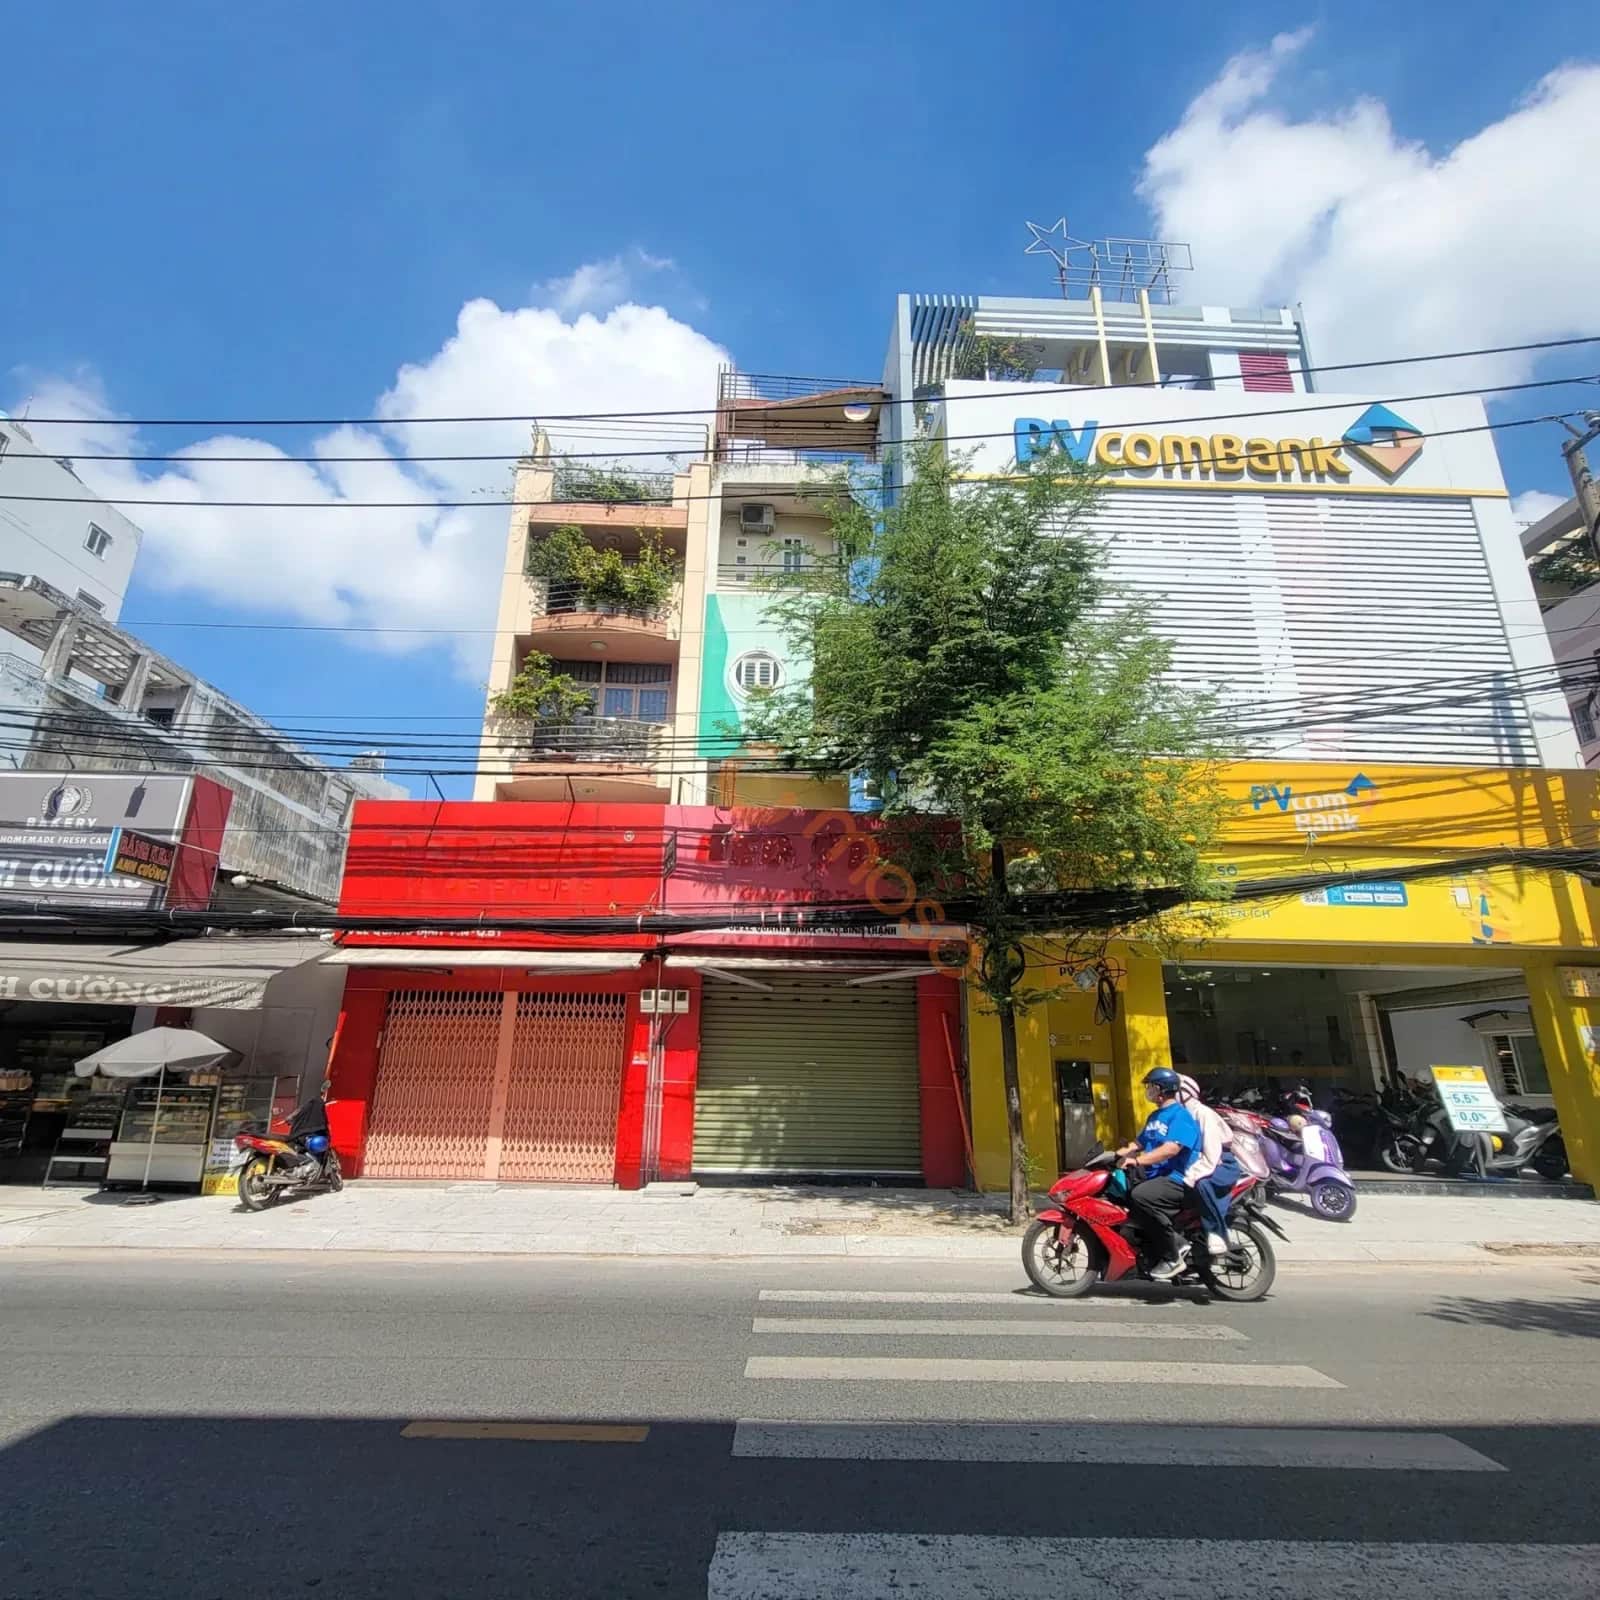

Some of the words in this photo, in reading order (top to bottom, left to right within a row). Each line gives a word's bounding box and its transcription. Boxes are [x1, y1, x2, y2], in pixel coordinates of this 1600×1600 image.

[1014, 416, 1352, 476] PVcomBank
[26, 817, 97, 828] BAKERY
[1295, 811, 1360, 832] Bank
[0, 835, 56, 845] HOMEMADE
[58, 836, 87, 845] FRESH
[90, 836, 109, 845] CAK
[29, 974, 172, 1003] CƯỜNG
